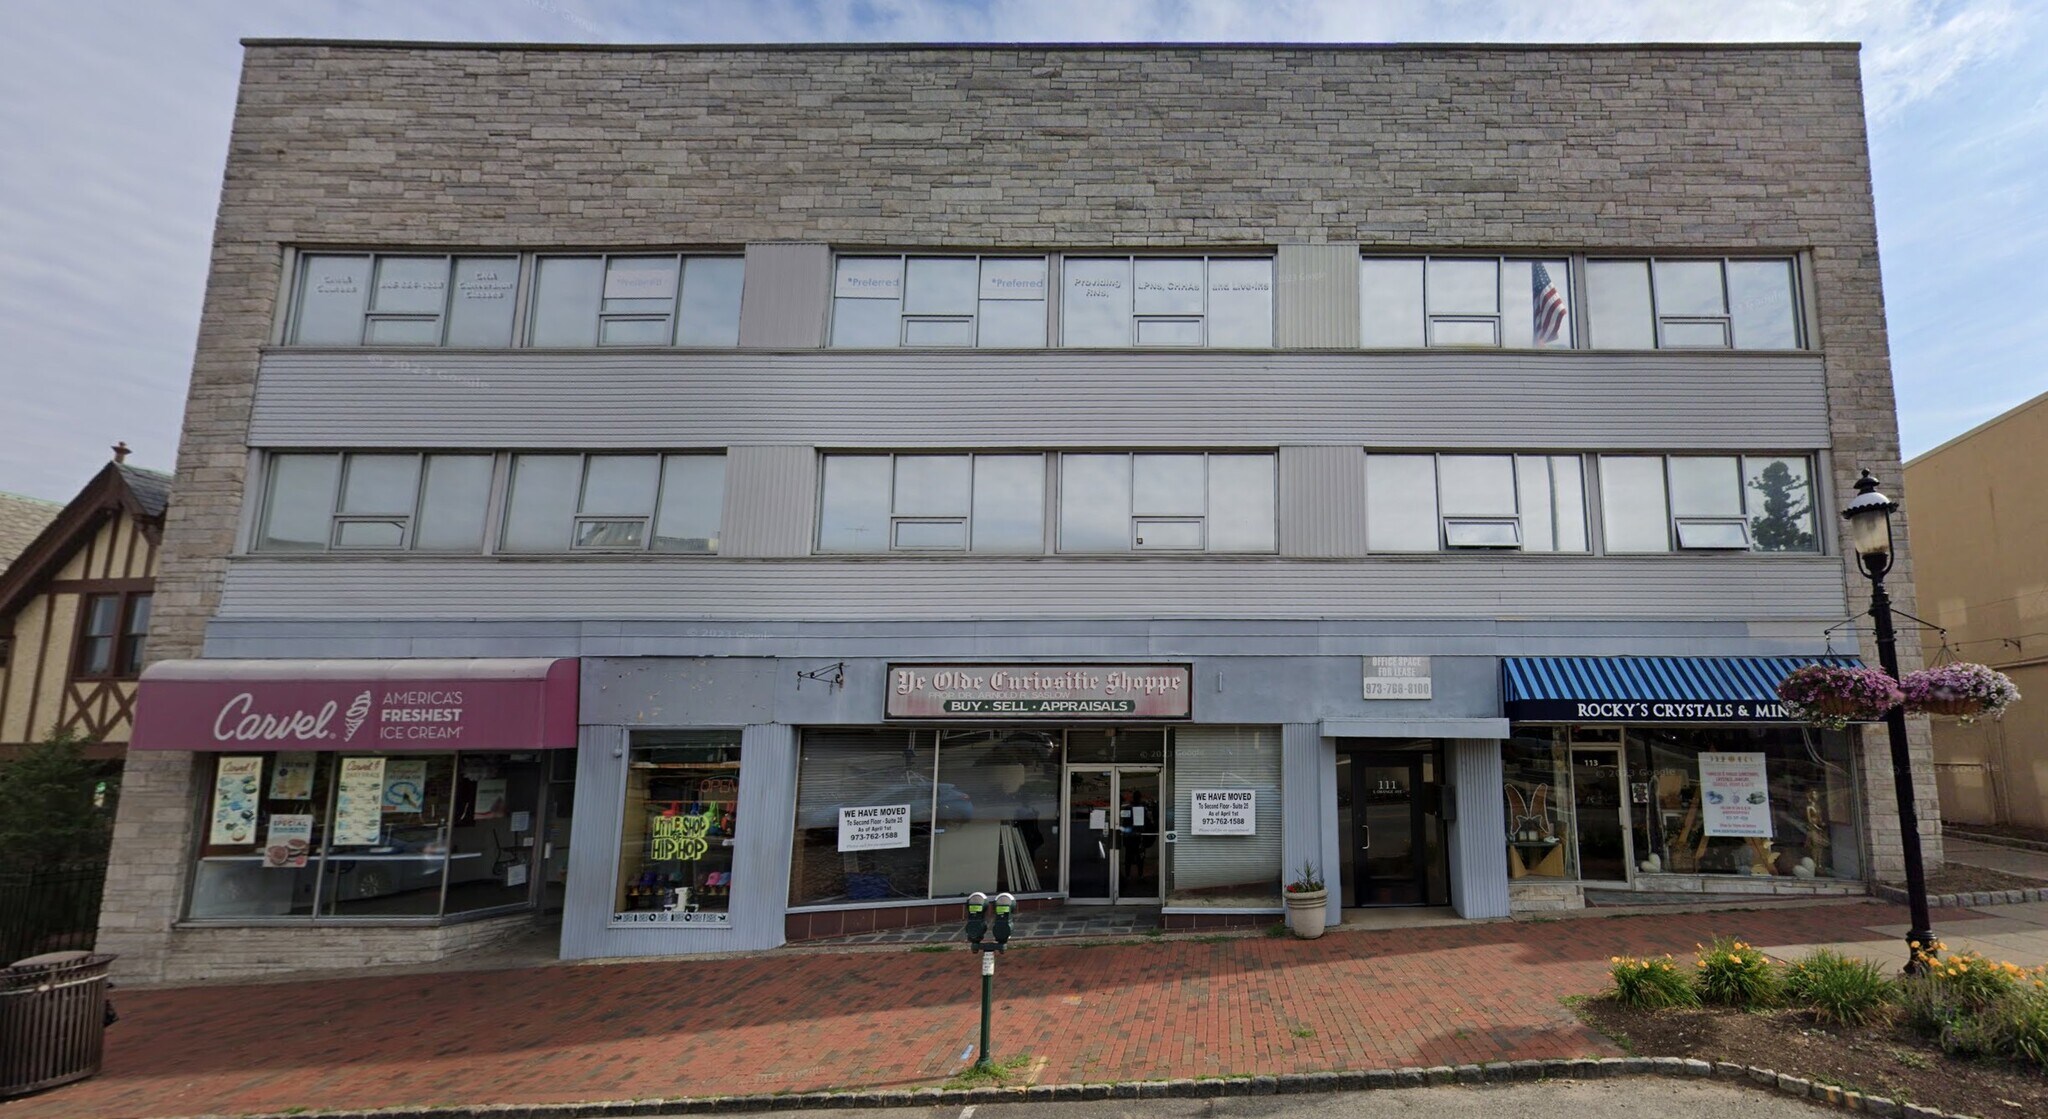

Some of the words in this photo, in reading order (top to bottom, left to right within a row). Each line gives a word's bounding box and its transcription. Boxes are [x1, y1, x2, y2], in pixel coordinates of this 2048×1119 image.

[1074, 278, 1122, 289] Providing
[1212, 282, 1230, 291] and
[1398, 656, 1421, 667] SPACE
[1378, 667, 1393, 676] FOR
[1394, 667, 1417, 677] LEASE
[896, 671, 926, 695] Ye
[932, 670, 983, 692] Olde
[989, 671, 1100, 692] Curiositie
[1105, 670, 1182, 696] Shoppe
[382, 691, 463, 705] AMERICA'S
[979, 691, 1018, 699] ARNOLD
[1031, 691, 1071, 699] SASLOW
[951, 701, 982, 711] BUY
[992, 701, 1029, 711] SELL
[1040, 701, 1128, 711] APPRAISALS
[1653, 703, 1733, 717] CRYSTALS
[1737, 704, 1750, 717] &
[1755, 704, 1790, 718] MIN
[213, 692, 338, 741] Carvel
[381, 708, 463, 722] FRESHEST
[380, 726, 403, 739] ICE
[407, 726, 461, 739] CREAM
[701, 780, 738, 793] OPEN
[1378, 780, 1396, 790] 111
[1196, 792, 1206, 801] WE
[1208, 792, 1227, 801] HAVE
[1228, 792, 1252, 801] MOVED
[844, 809, 856, 818] WE
[858, 808, 878, 817] HAVE
[880, 807, 906, 816] MOVED
[681, 815, 710, 838] SHOP
[853, 818, 869, 826] Second
[850, 832, 898, 841] 973-762-1588
[651, 838, 677, 860] HIP
[676, 838, 709, 860] HOP
